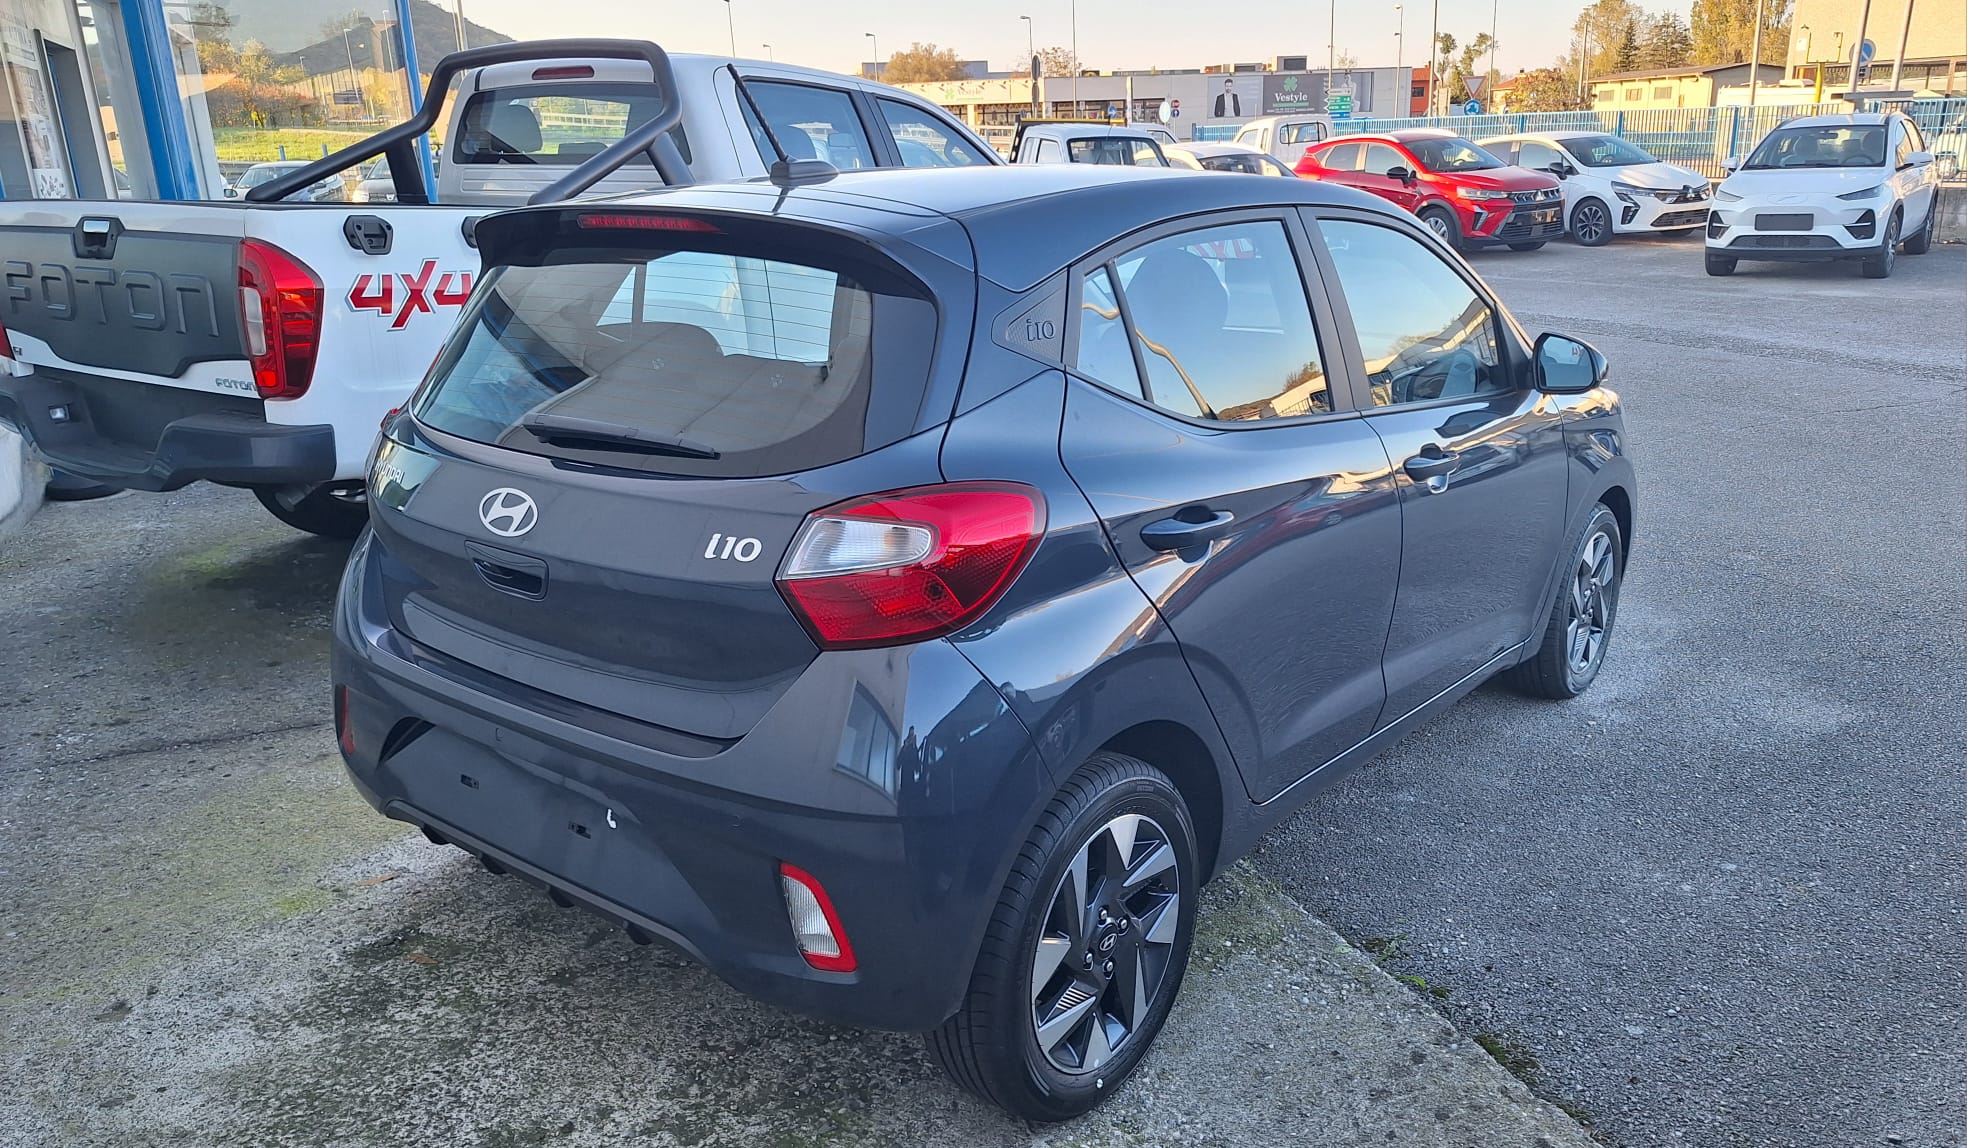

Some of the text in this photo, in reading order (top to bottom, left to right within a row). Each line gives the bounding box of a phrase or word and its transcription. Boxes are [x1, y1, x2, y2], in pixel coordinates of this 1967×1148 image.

[1274, 92, 1308, 103] Vestyle
[3, 260, 219, 337] FOTON
[215, 377, 257, 391] FOTON
